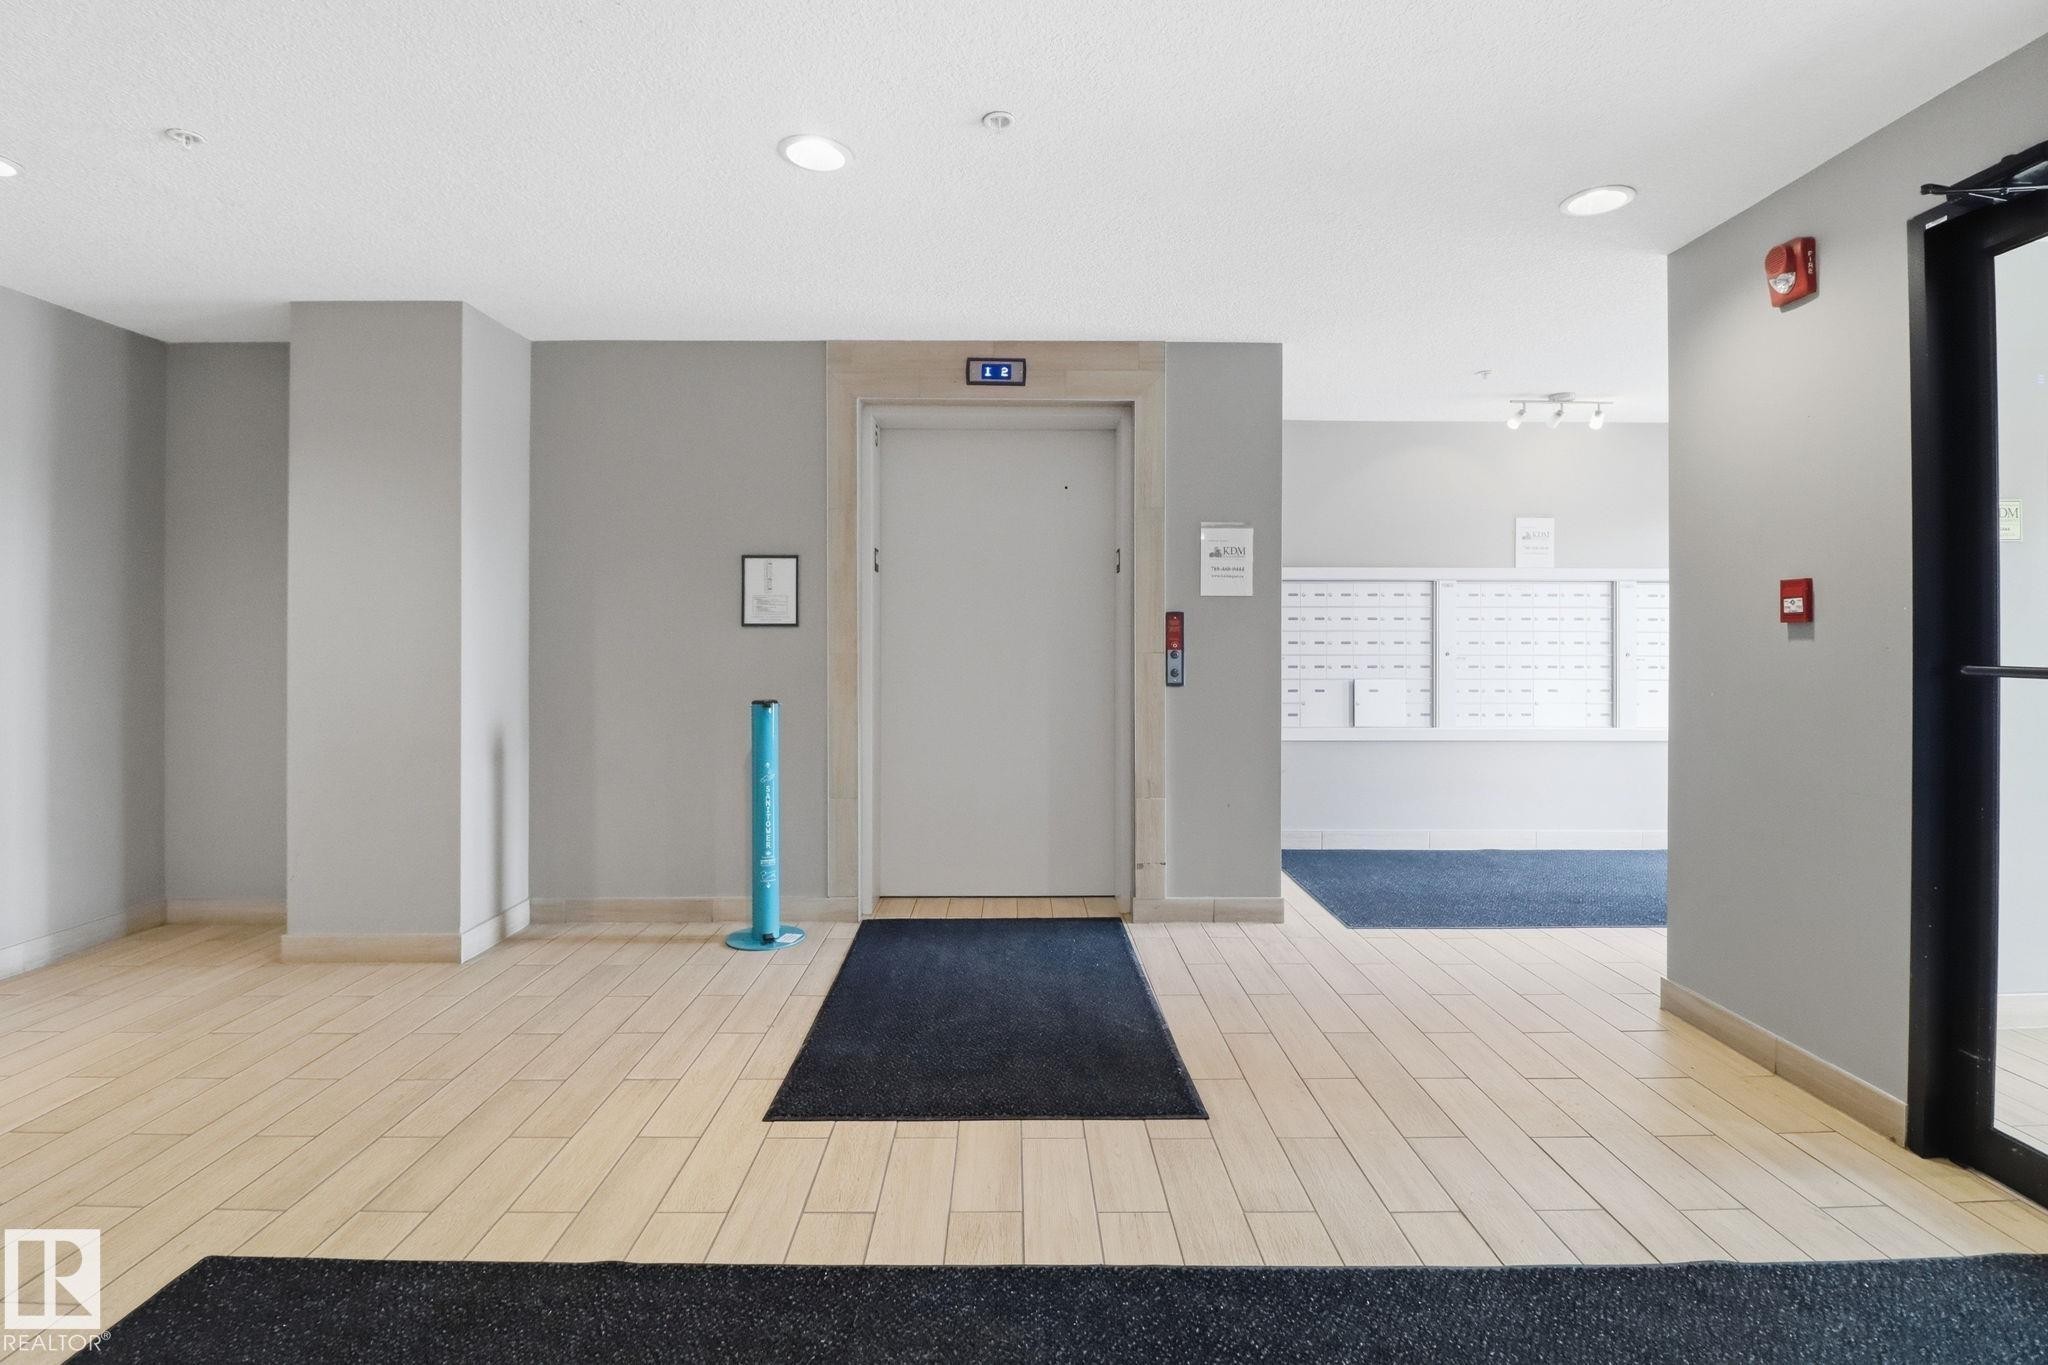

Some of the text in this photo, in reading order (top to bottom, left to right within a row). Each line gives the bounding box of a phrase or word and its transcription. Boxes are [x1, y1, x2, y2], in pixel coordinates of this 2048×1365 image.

[1000, 366, 1009, 377] 2
[2000, 507, 2019, 518] DM
[1223, 546, 1246, 556] KDM
